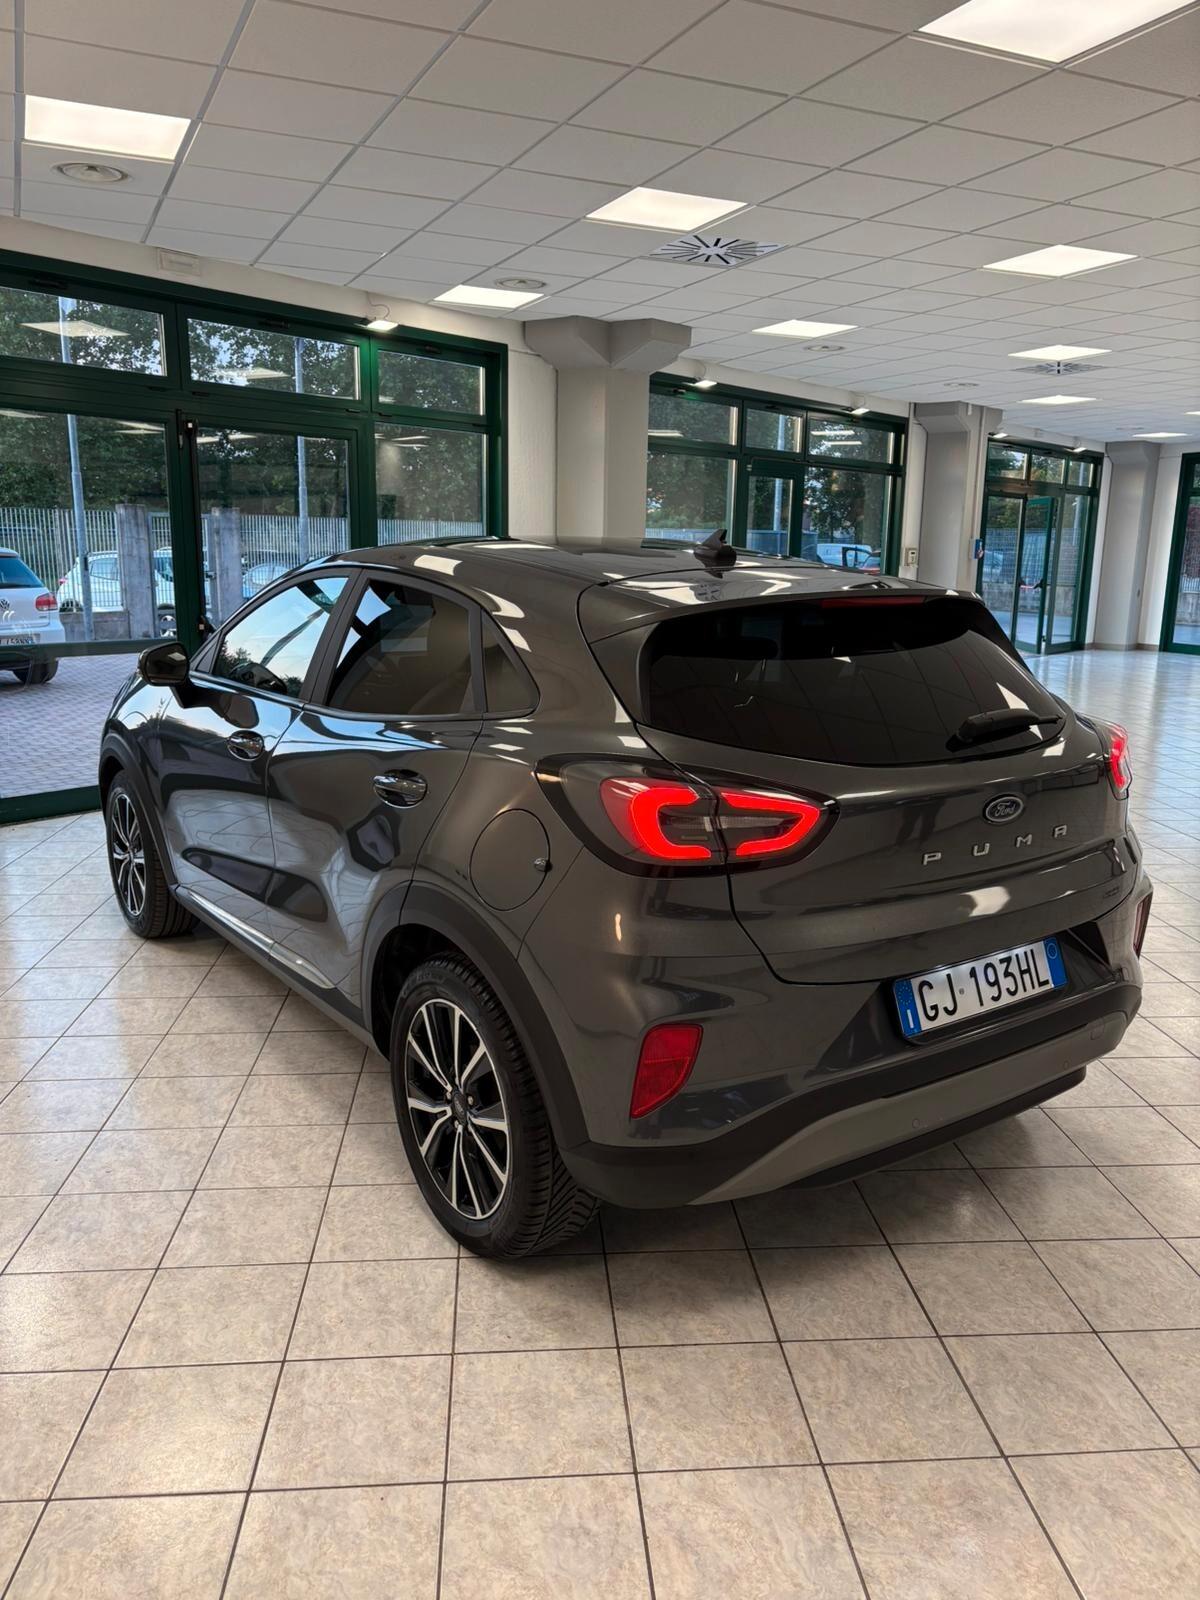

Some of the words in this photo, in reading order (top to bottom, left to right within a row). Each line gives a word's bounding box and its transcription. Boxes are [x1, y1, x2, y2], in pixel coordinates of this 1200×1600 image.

[994, 802, 1017, 817] Ford
[923, 824, 1068, 866] PUMA
[918, 973, 958, 1022] GJ
[969, 948, 1050, 1007] 193HL
